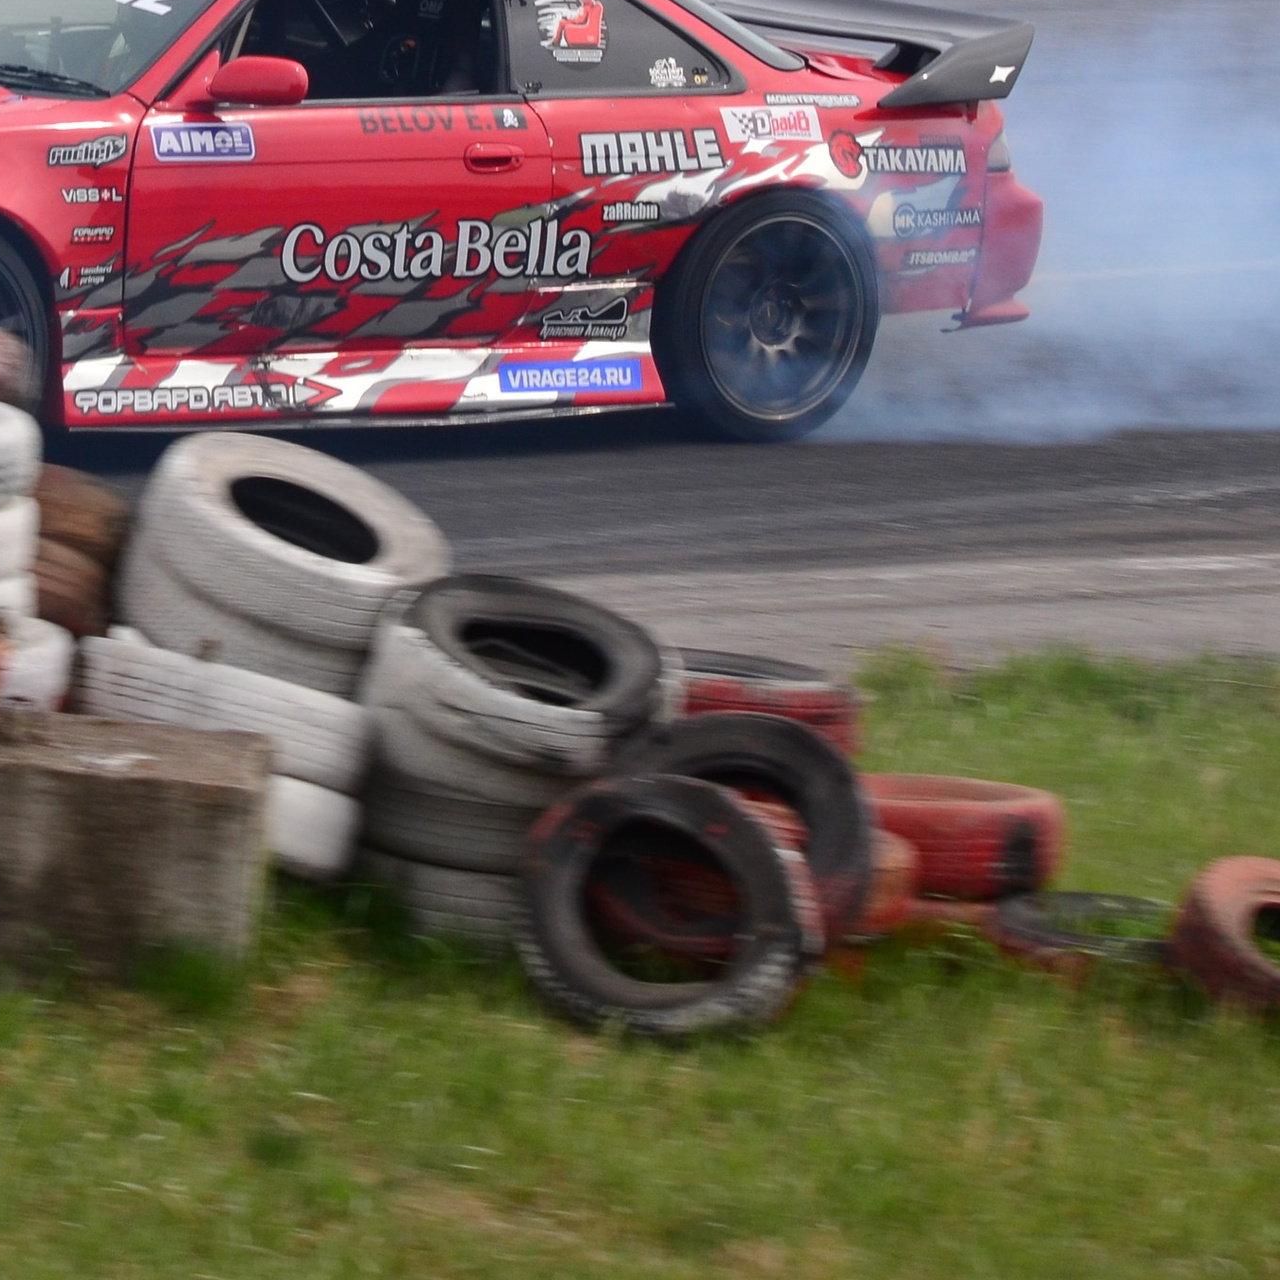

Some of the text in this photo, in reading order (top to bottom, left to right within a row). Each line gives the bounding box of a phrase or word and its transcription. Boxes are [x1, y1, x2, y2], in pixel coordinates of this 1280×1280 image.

[357, 105, 493, 134] BELOV E.
[159, 130, 250, 153] AIMOL
[580, 128, 725, 175] MAHLE
[863, 147, 967, 174] TAKAYAMA
[602, 201, 659, 221] zaRRubin
[917, 209, 981, 228] KASHIYAMA
[507, 367, 632, 390] VIRAGE24.RU
